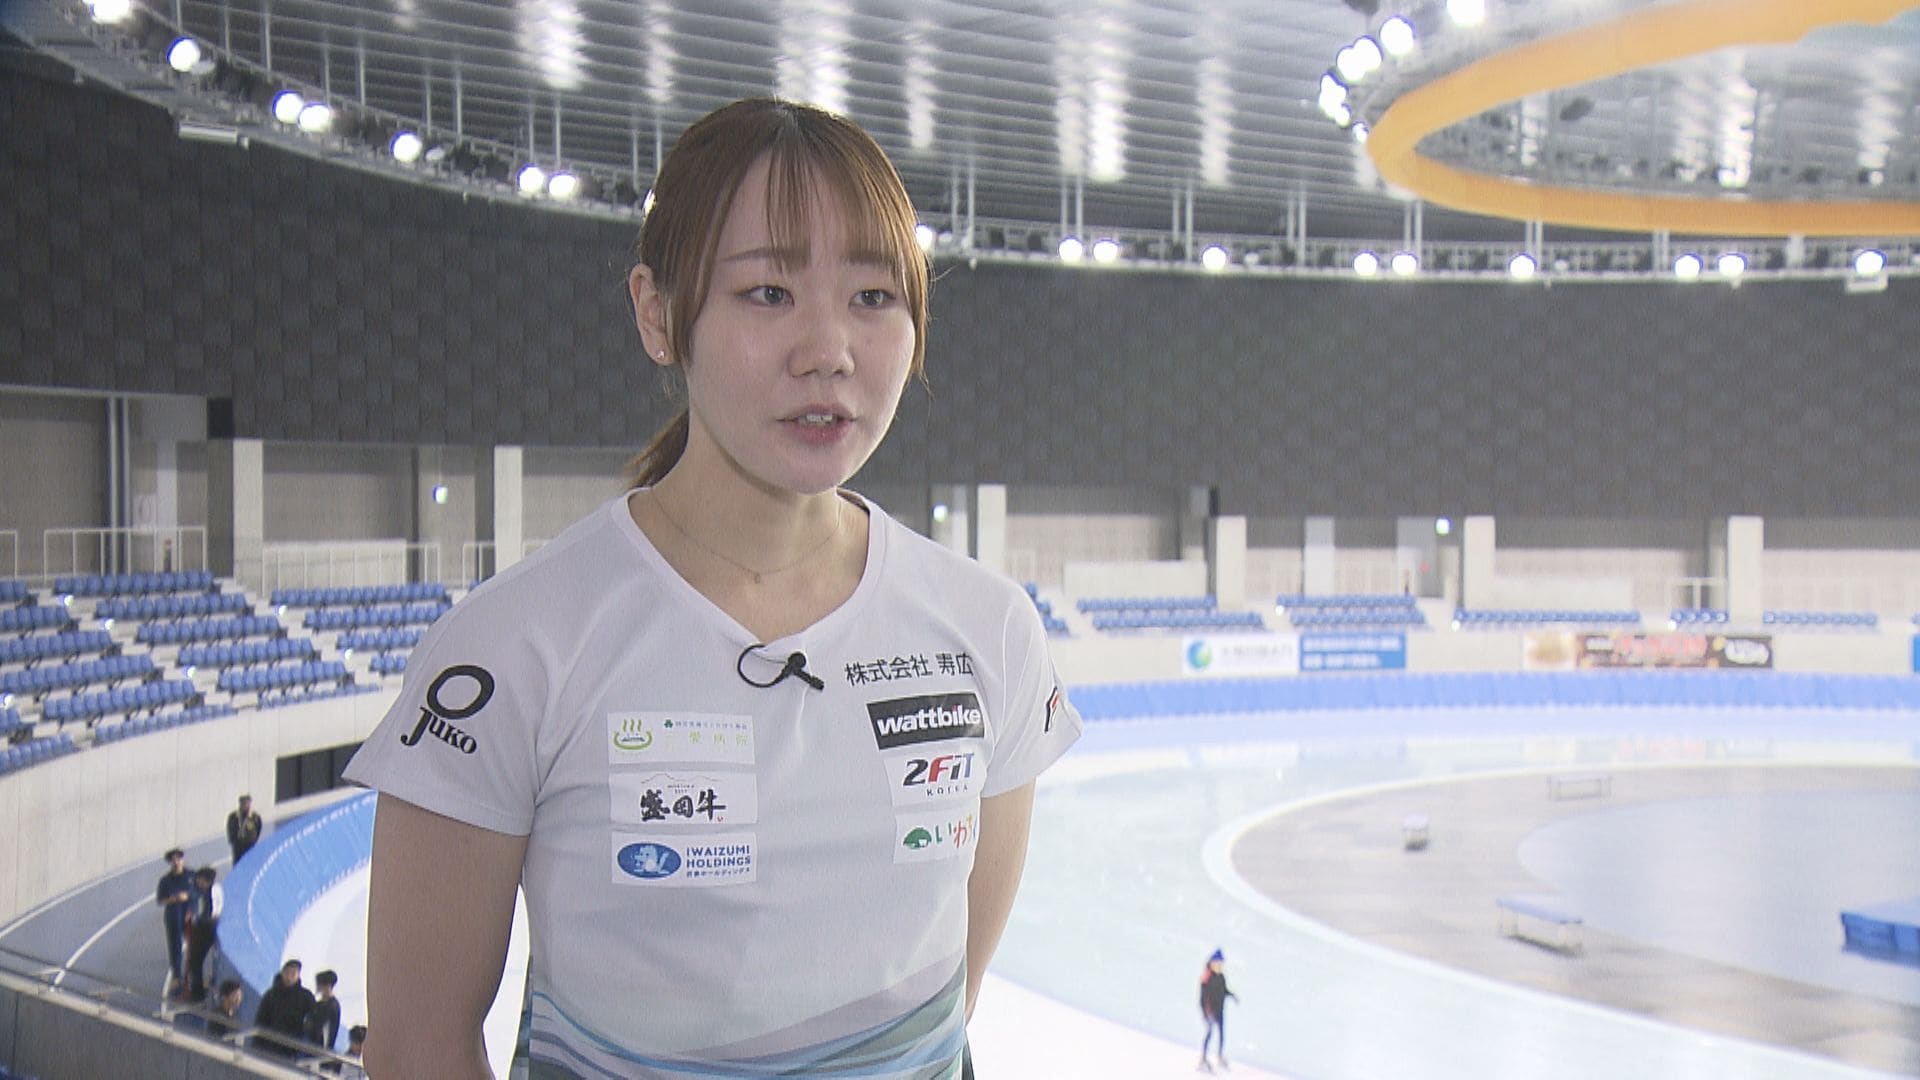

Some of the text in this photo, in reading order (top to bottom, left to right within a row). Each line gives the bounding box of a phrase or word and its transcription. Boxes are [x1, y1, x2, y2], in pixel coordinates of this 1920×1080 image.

[844, 652, 974, 686] 株式会社 寿広
[876, 704, 981, 737] wattbike
[686, 845, 750, 857] IWAIZUMI
[686, 856, 751, 868] HOLDINGS
